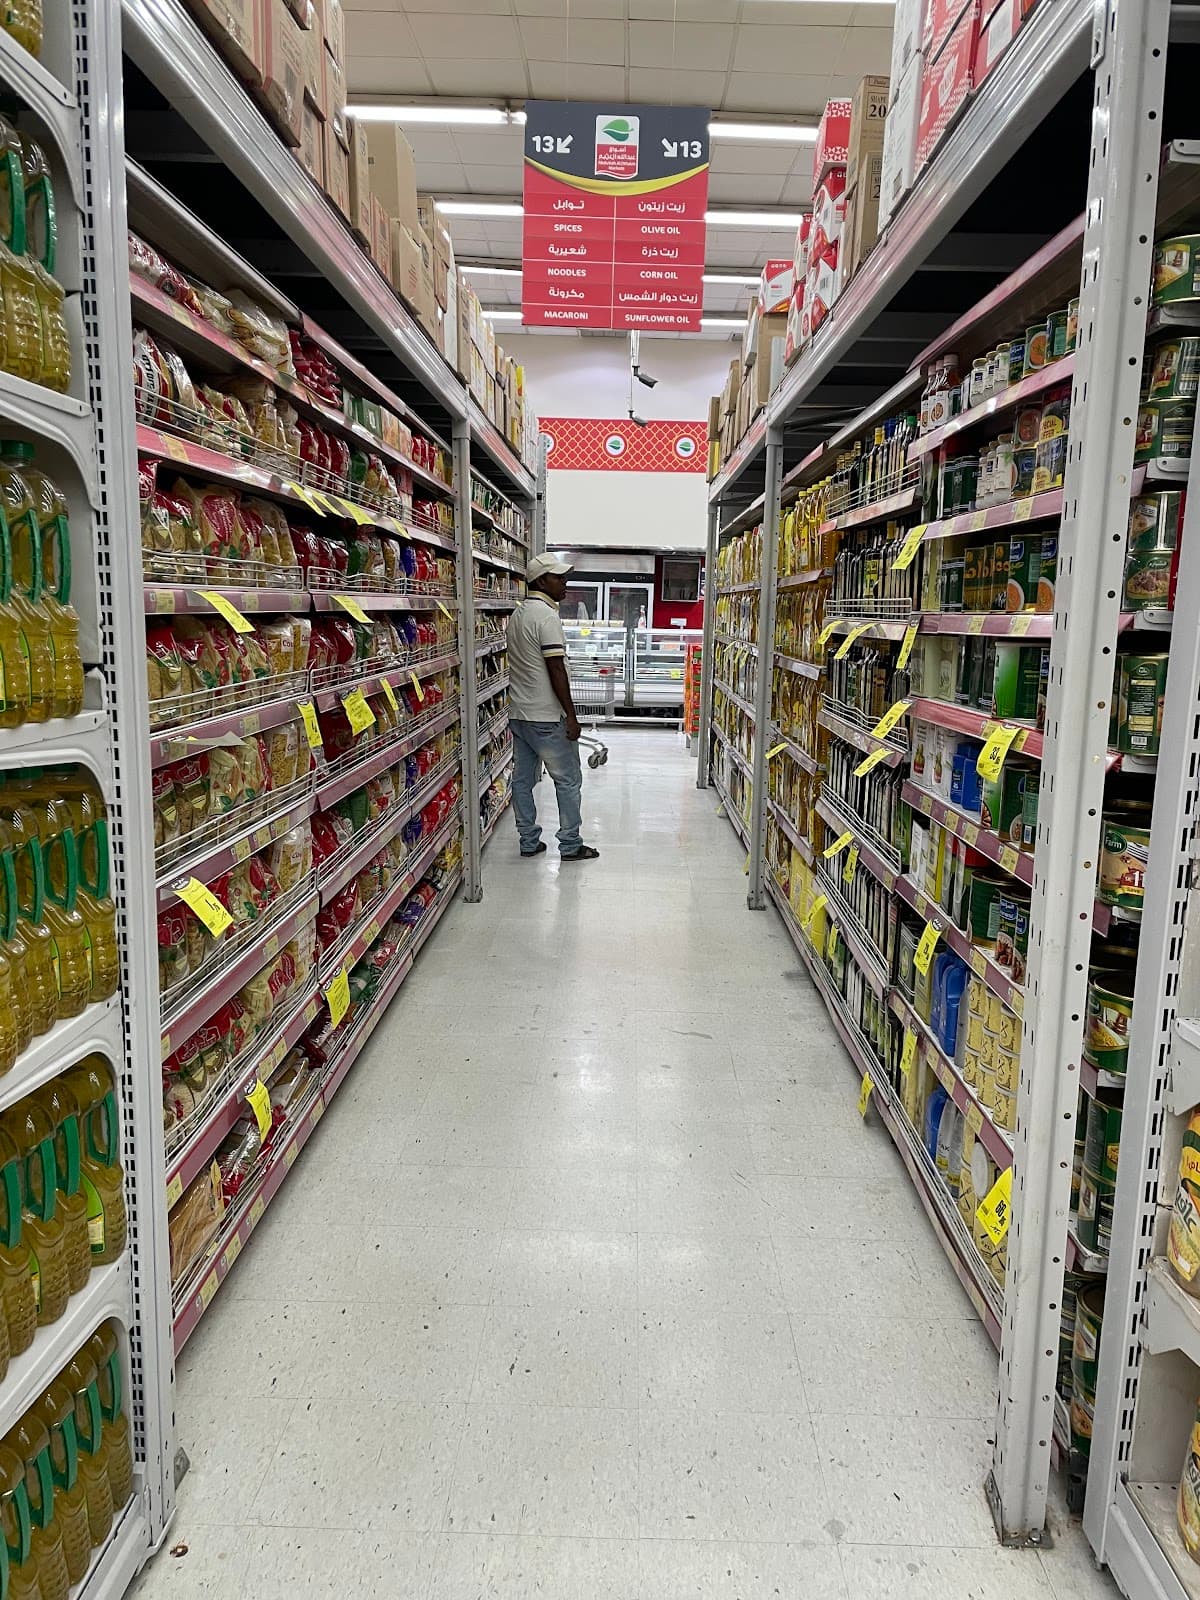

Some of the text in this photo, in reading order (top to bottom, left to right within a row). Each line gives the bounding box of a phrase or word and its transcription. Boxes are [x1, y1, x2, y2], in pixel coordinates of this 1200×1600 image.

[869, 104, 887, 118] 20
[532, 135, 554, 153] 13
[680, 141, 702, 158] 13
[873, 184, 881, 199] 2
[638, 200, 686, 212] زيت زيتون
[553, 223, 583, 232] SPICES
[641, 225, 681, 235] OLIVE OIL
[548, 244, 587, 256] شعيرية
[641, 246, 679, 259] زيت ذرة
[547, 268, 587, 277] NOODLES
[640, 270, 679, 280] CORN OIL
[548, 286, 585, 299] مكرونة
[618, 291, 698, 304] زيت دوار الشمس
[544, 310, 589, 320] MACARONI
[624, 314, 690, 325] SUNFLOWER OIL
[1105, 836, 1122, 849] Farm
